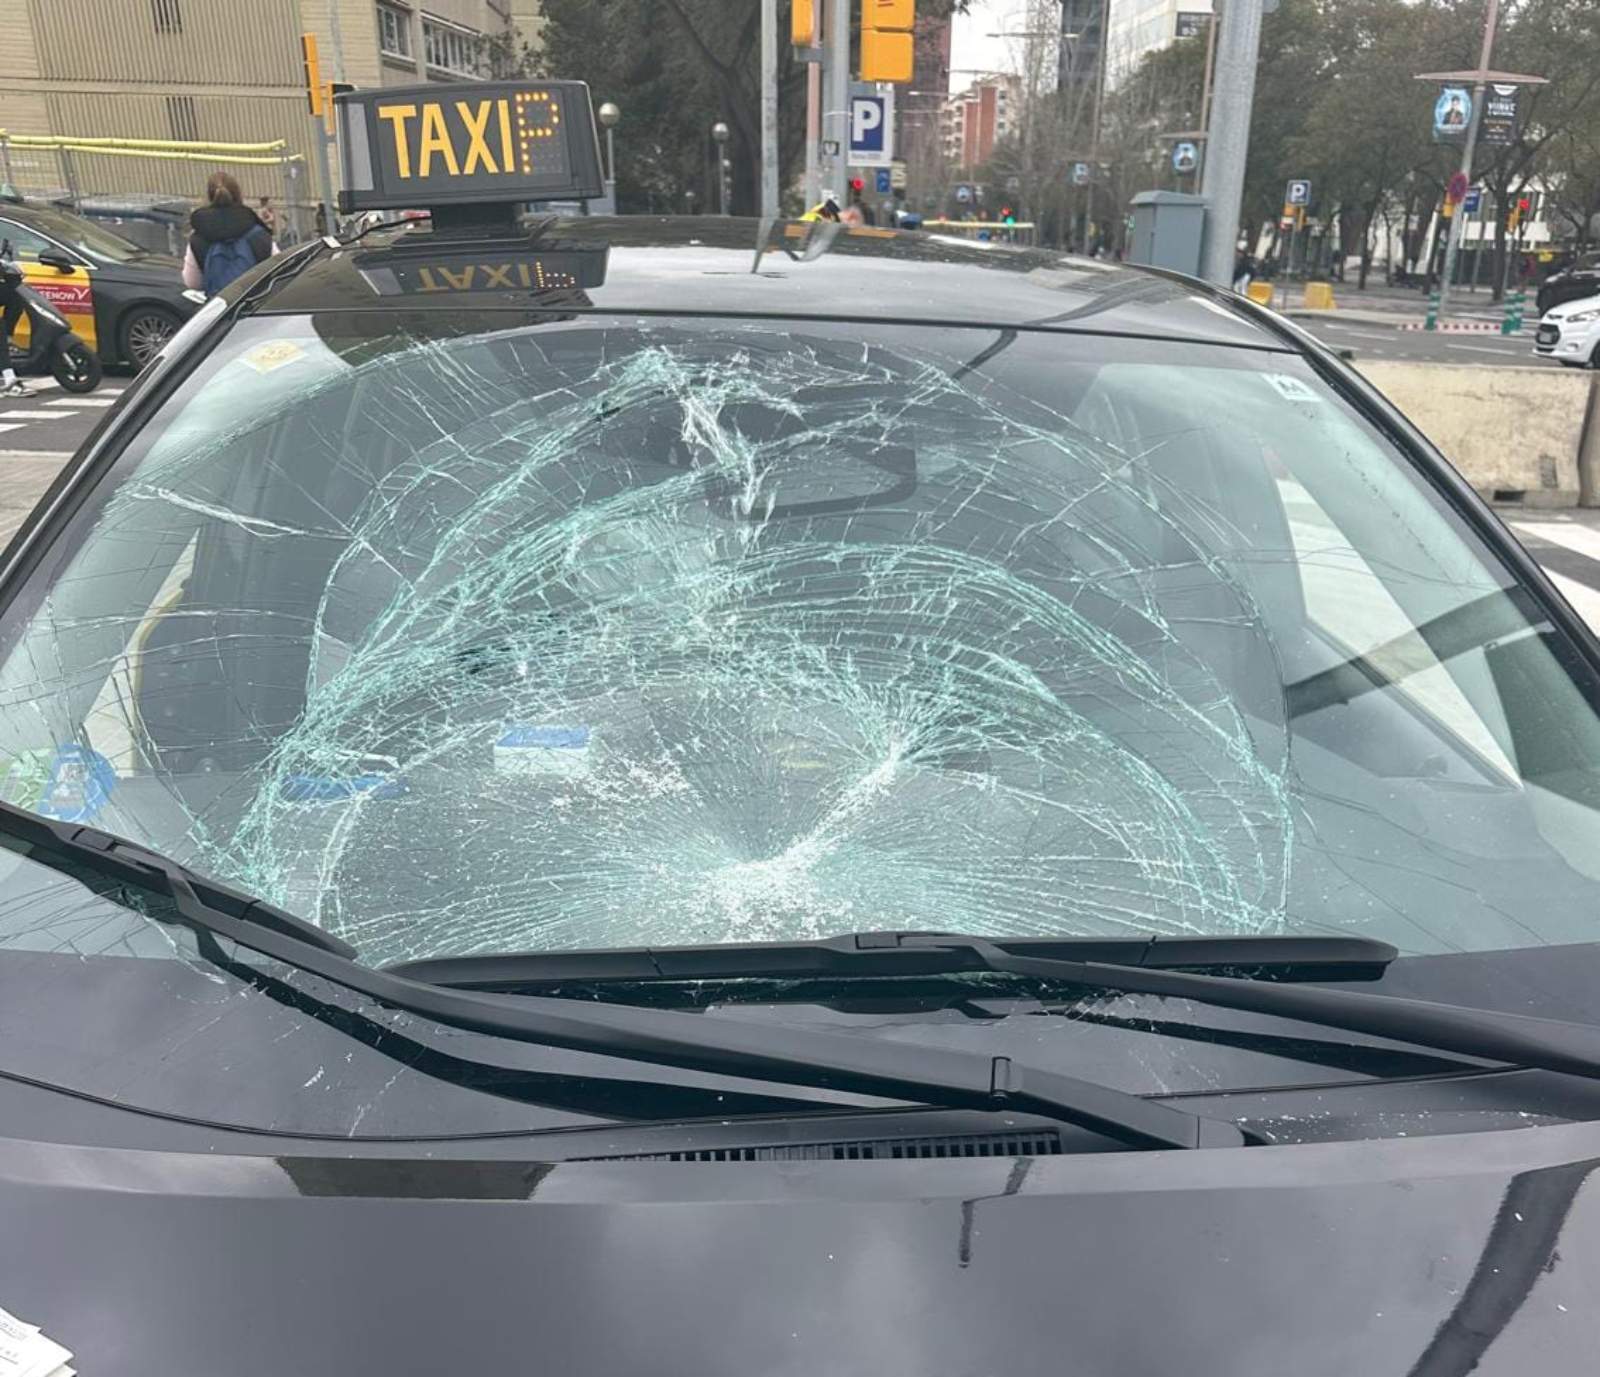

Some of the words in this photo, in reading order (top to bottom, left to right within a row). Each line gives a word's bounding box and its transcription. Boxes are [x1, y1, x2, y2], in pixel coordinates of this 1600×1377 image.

[378, 99, 515, 178] TAXI
[853, 100, 881, 142] P
[1291, 184, 1305, 202] P
